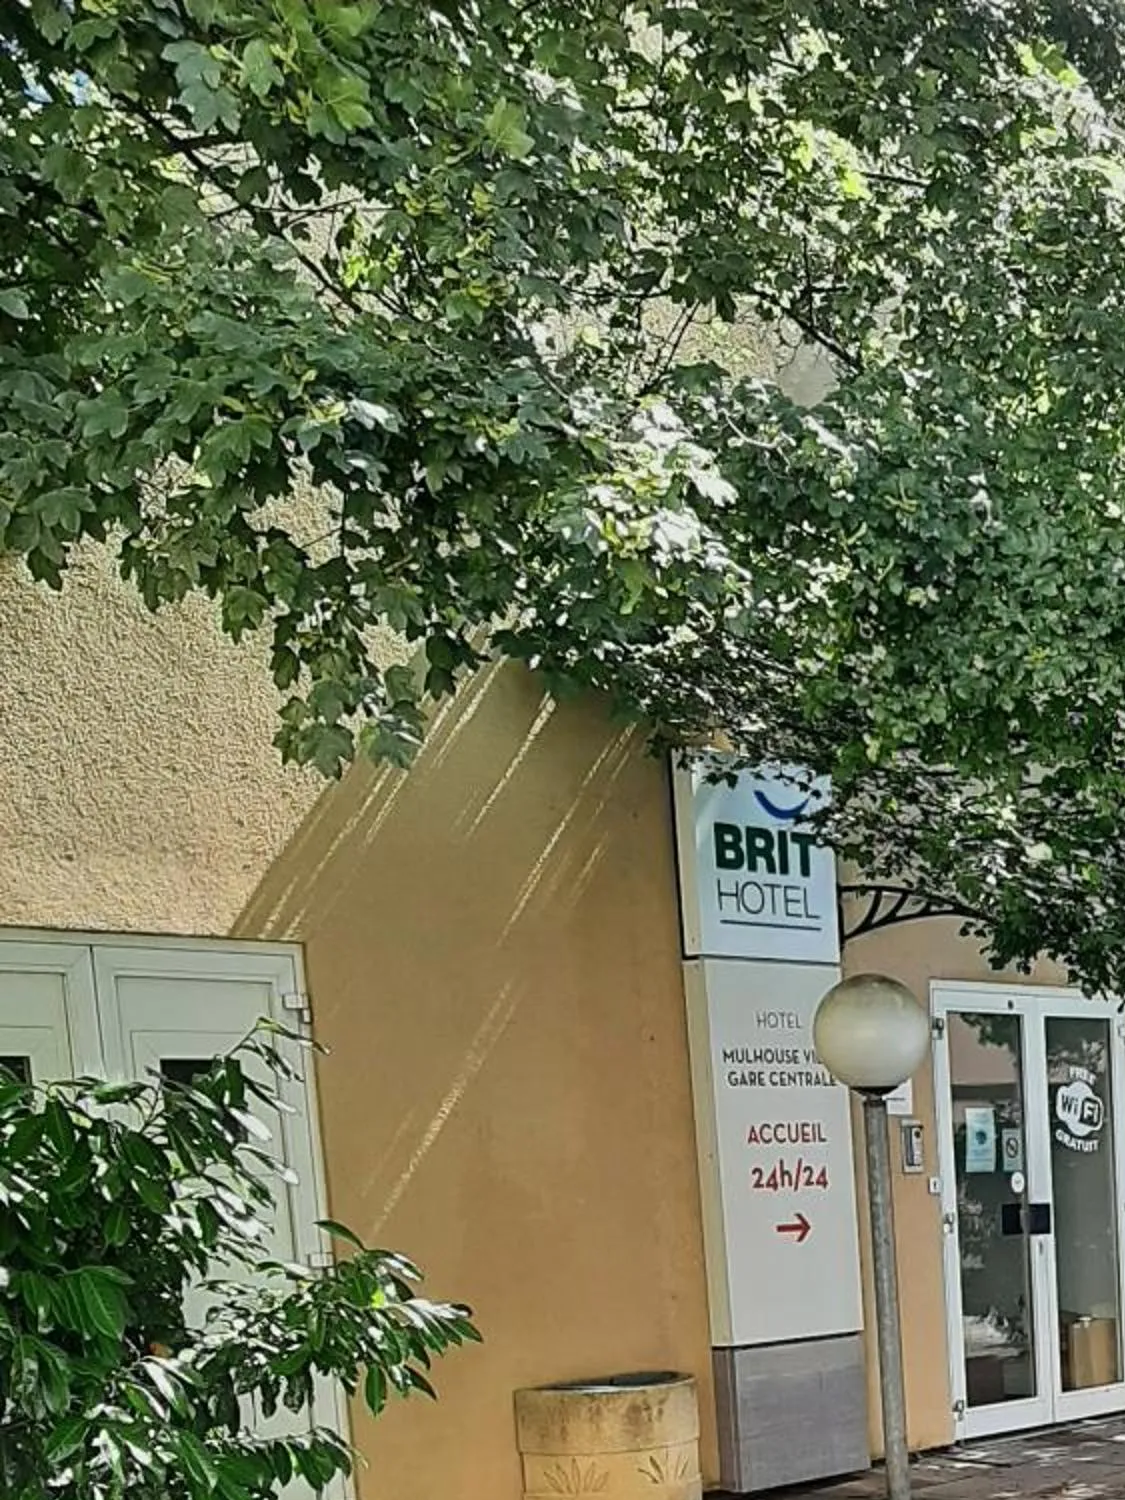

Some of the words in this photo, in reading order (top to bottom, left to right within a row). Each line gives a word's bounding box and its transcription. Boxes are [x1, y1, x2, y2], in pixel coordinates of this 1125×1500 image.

[714, 822, 818, 877] BRIT
[717, 878, 821, 919] HOTEL
[756, 1011, 803, 1030] HOTEL
[722, 1048, 799, 1064] MULHOUSE
[803, 1049, 824, 1064] VI
[727, 1071, 766, 1087] GARE
[1069, 1066, 1097, 1085] FREE
[748, 1124, 827, 1144] ACCUEIL
[1055, 1129, 1099, 1153] GRATUIT
[751, 1159, 829, 1191] 24h/24
